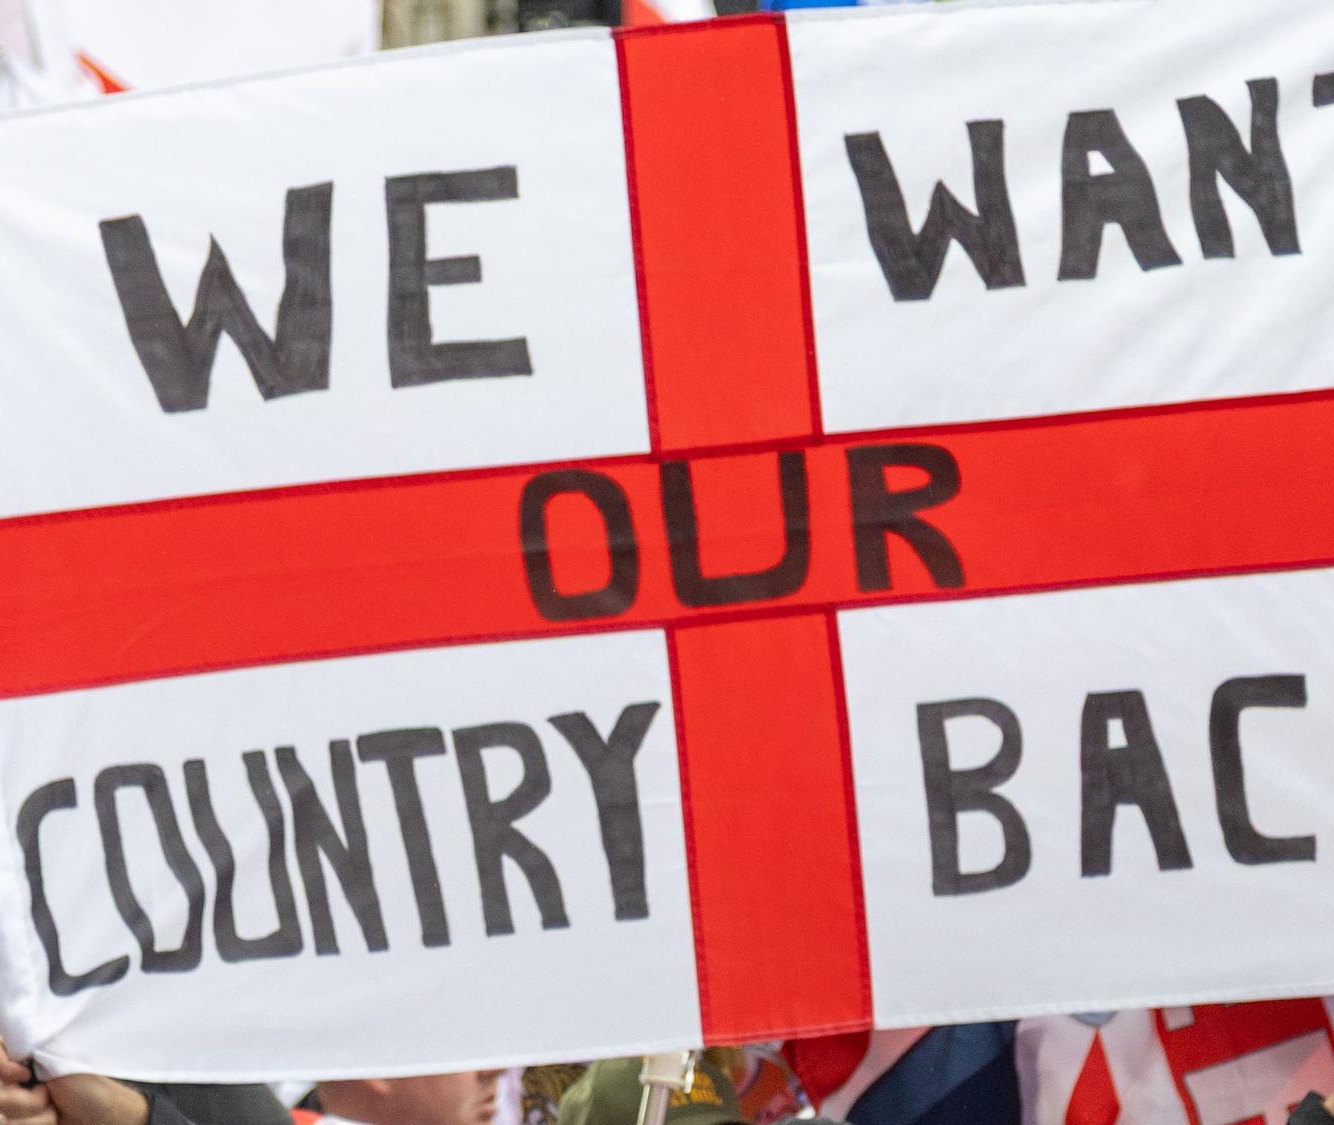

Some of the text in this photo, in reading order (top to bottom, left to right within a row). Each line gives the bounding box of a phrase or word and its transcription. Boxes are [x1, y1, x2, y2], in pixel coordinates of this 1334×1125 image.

[99, 165, 534, 413] WE
[519, 443, 965, 622] OUR
[15, 701, 662, 994] COUNTRY
